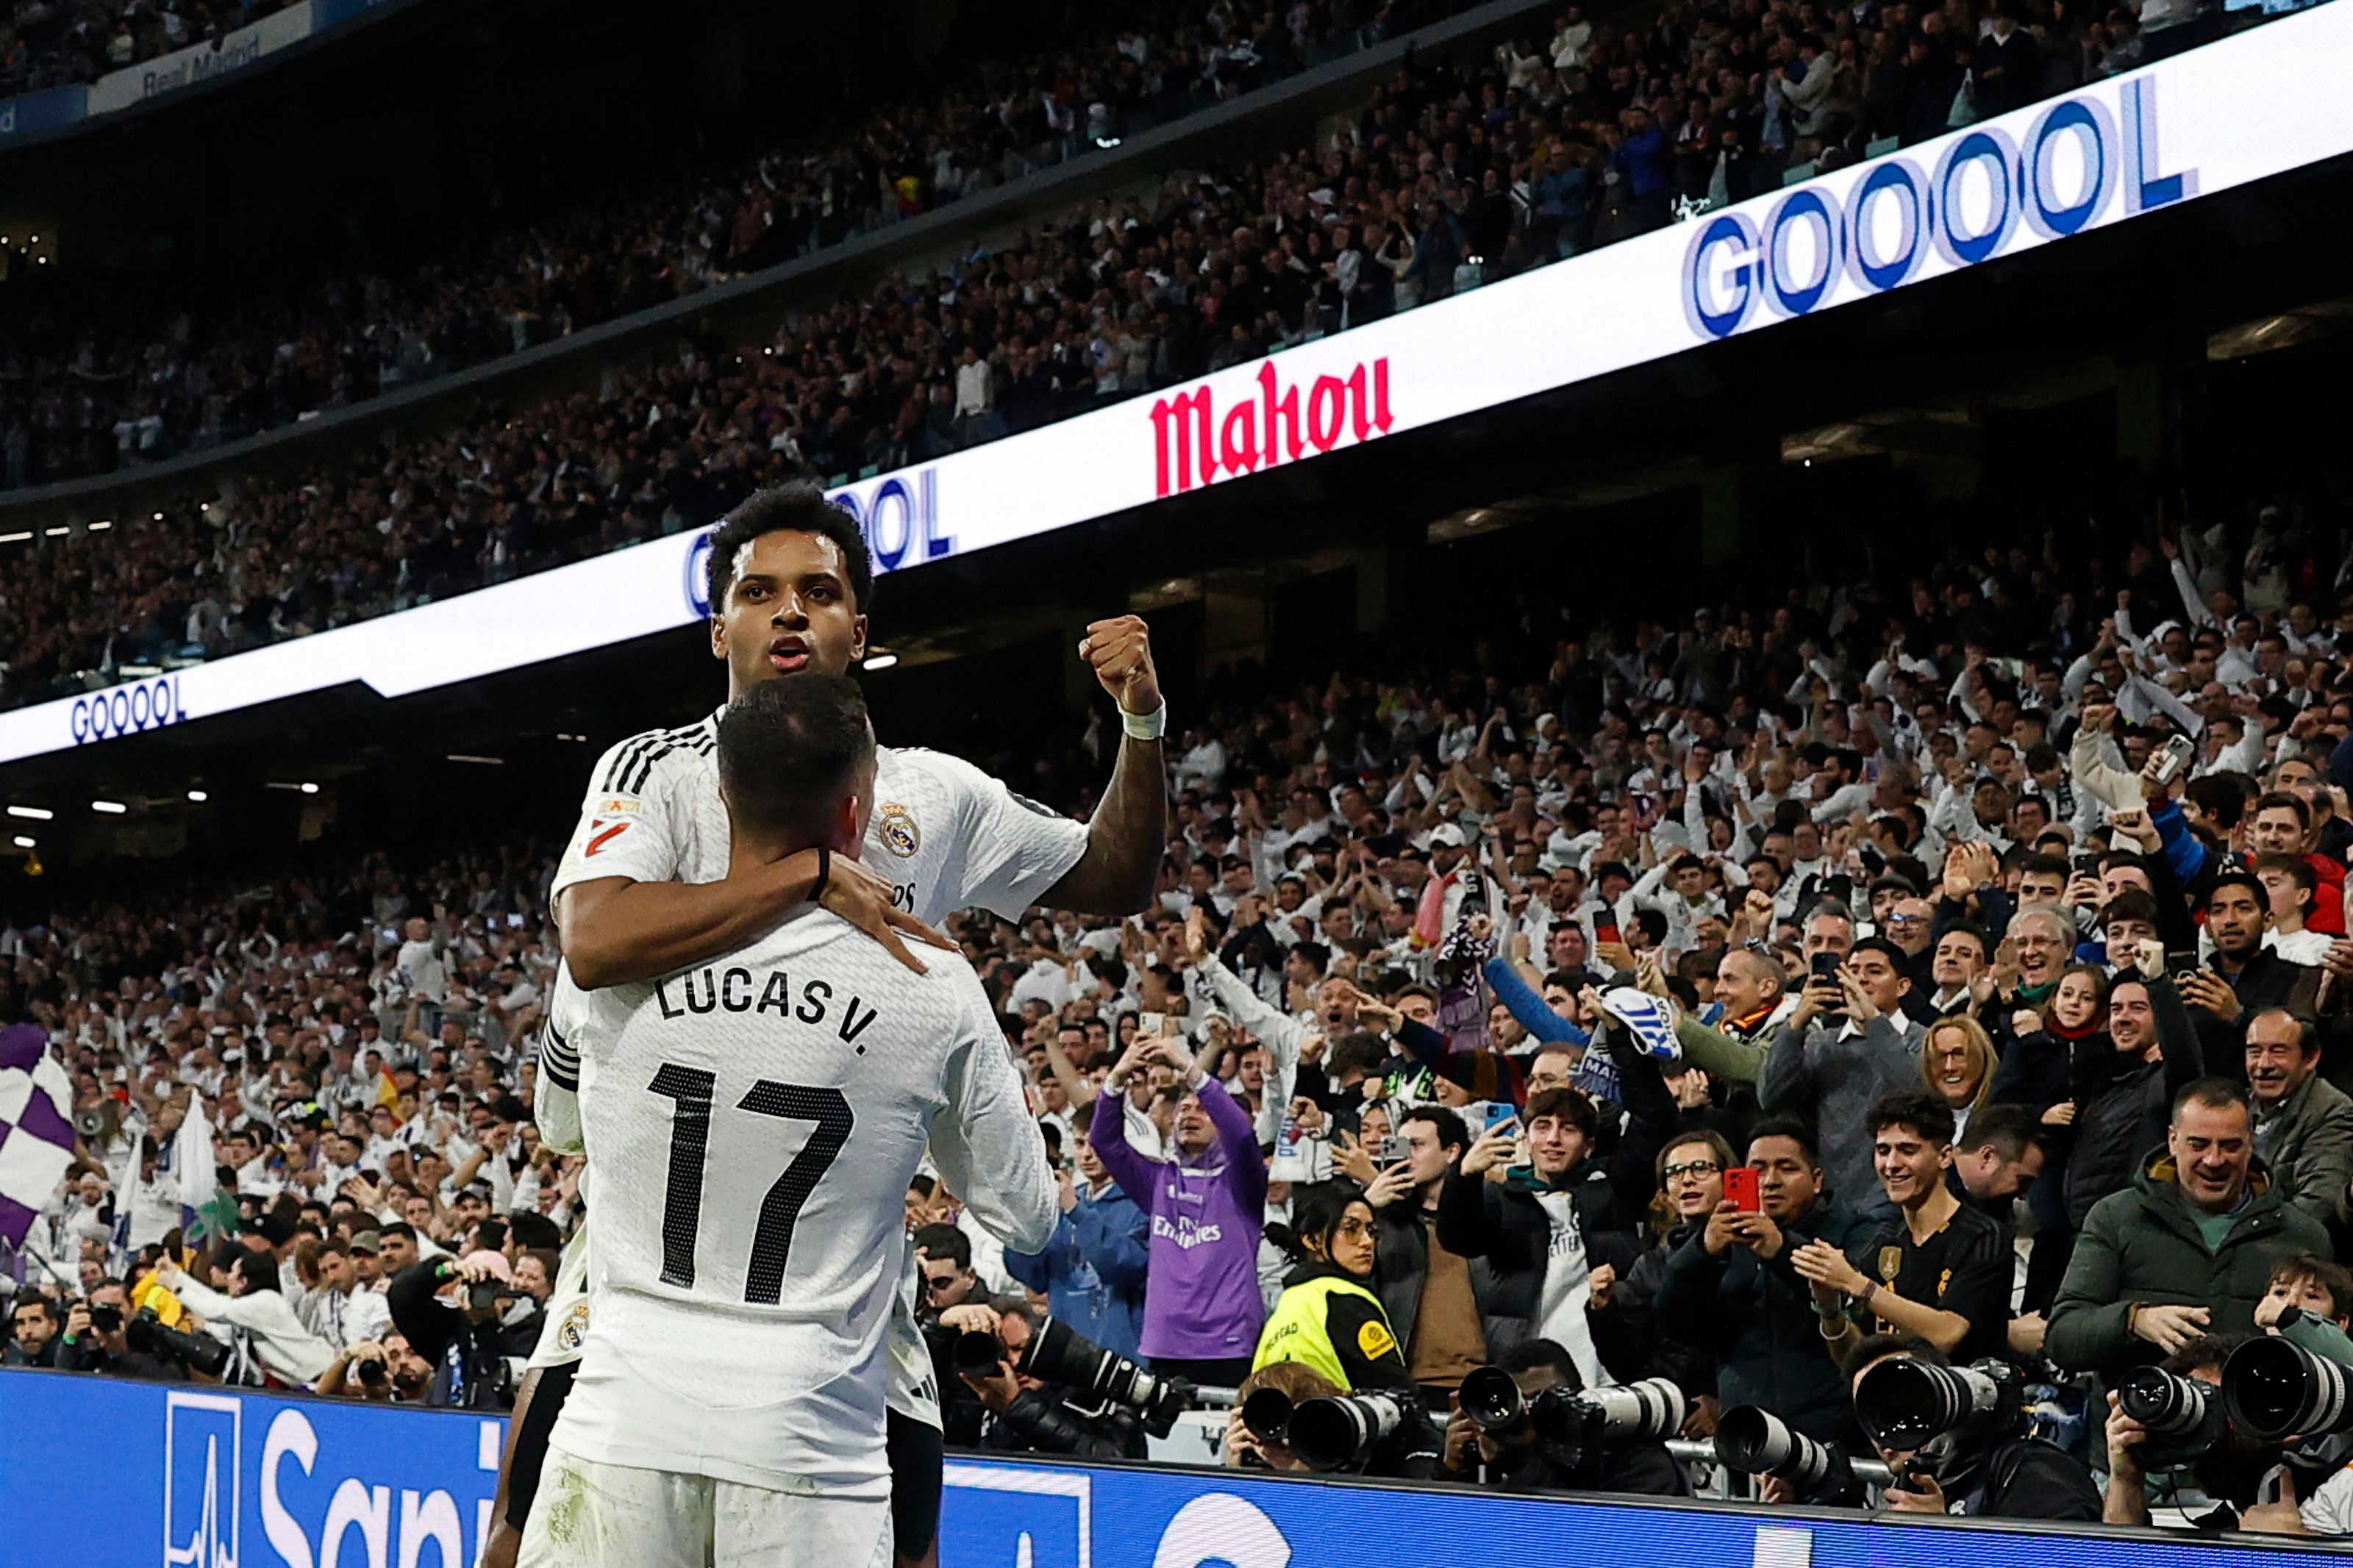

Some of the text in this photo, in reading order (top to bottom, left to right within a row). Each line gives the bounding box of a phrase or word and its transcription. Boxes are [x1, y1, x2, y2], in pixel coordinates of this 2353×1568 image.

[1682, 73, 2199, 341] GOOOOL
[1150, 356, 1395, 499] Mahou
[71, 674, 186, 746] GOOOOL
[654, 966, 879, 1056] LUCAS V.
[646, 1062, 854, 1305] 17
